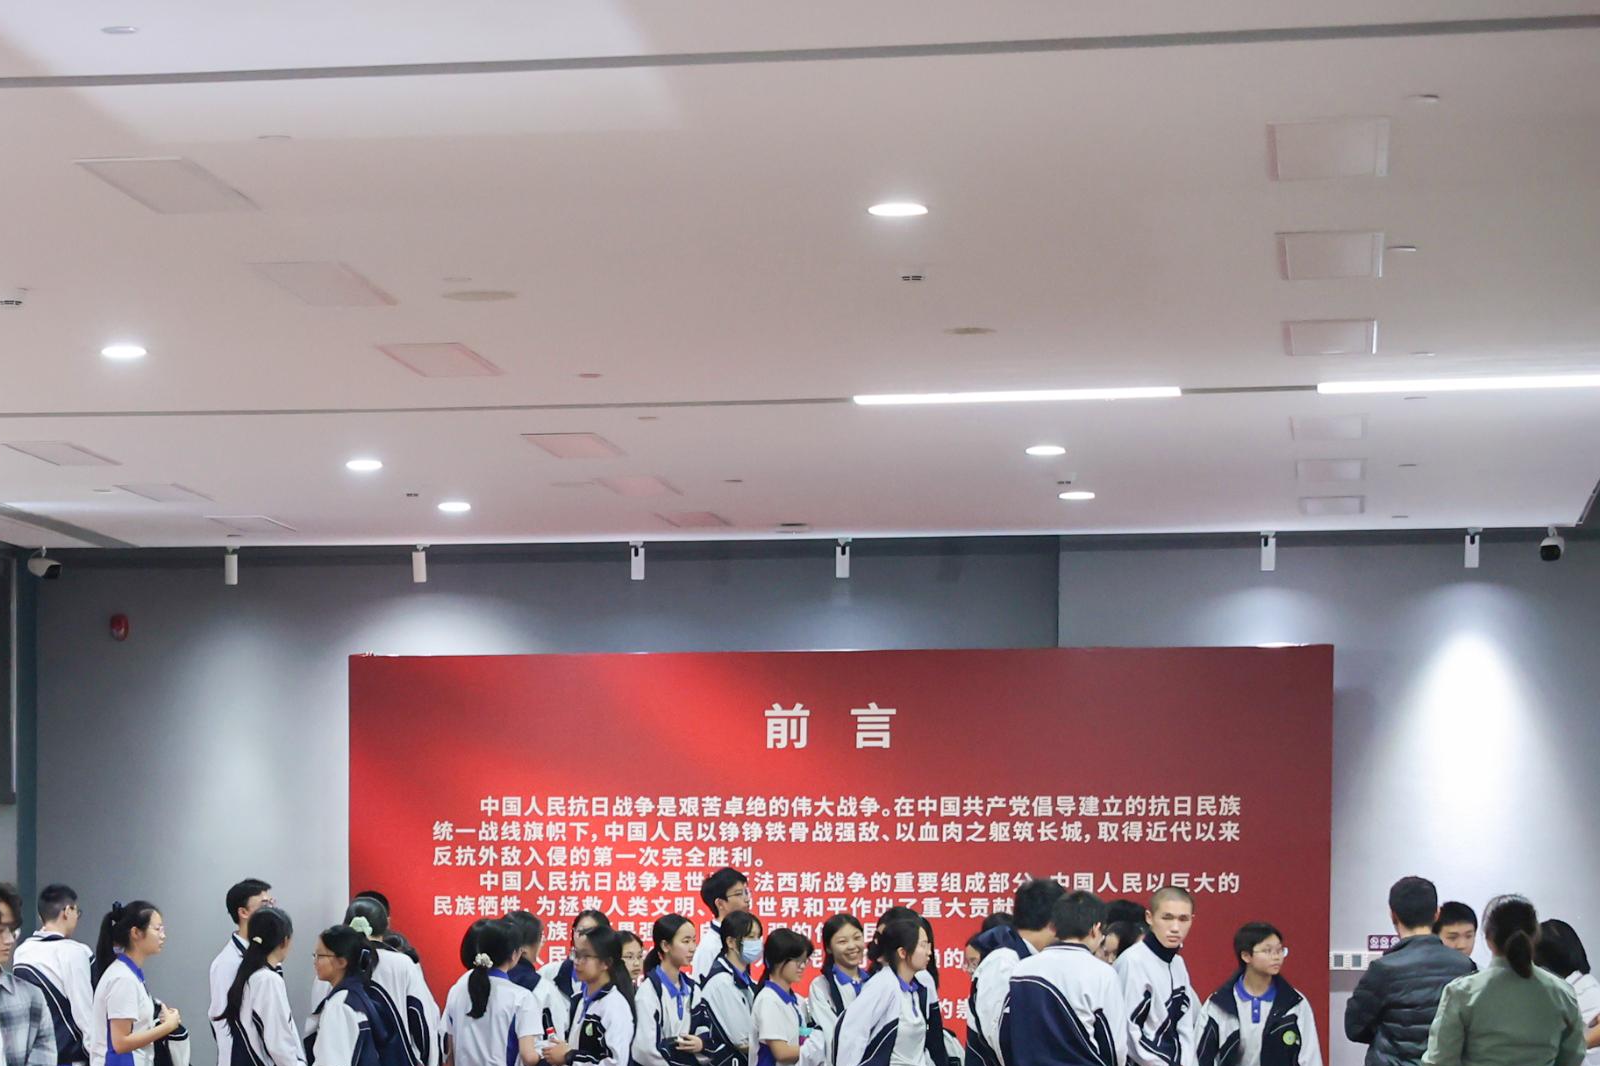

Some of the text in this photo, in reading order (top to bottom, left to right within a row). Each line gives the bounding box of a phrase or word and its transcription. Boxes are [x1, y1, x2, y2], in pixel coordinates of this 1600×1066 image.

[480, 795, 1241, 818] 中国人民抗日战争是艰苦卓绝的伟大战争。在中国共产党倡导建立的抗日民族
[433, 846, 764, 868] 反抗外敌入侵的第一次完全胜利。
